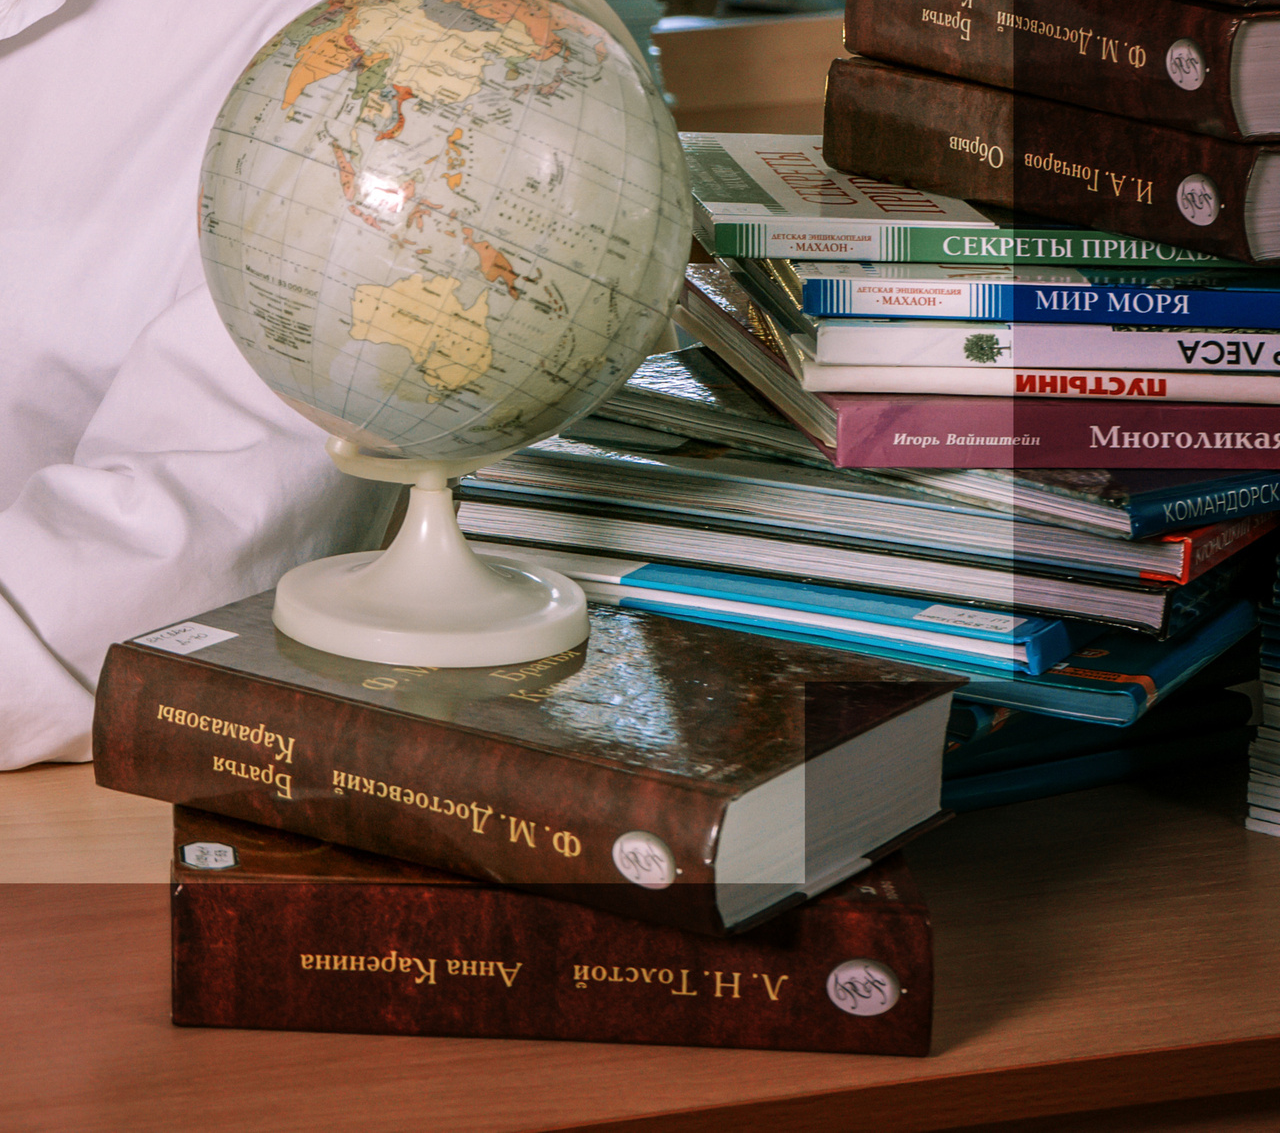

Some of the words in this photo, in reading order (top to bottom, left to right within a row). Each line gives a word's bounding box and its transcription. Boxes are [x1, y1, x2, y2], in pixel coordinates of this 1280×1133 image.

[922, 8, 972, 42] Братья
[996, 10, 1094, 56] Достоевский
[949, 135, 1005, 169] Обрыв
[755, 150, 859, 207] СЕКРЕТЫ
[1023, 152, 1101, 193] Гончаров
[771, 233, 807, 243] ДЕТСКАЯ
[808, 233, 873, 243] ЭНЦИКЛОПЕДИЯ
[795, 242, 849, 254] МАХАОН
[942, 235, 1074, 259] СЕКРЕТЫ
[857, 286, 893, 297] ДЕТСКАЯ
[894, 287, 963, 297] ЭНЦИКЛОПЕДИЯ
[881, 295, 939, 308] МАХАОН
[1035, 289, 1100, 313] МИР
[1107, 291, 1191, 316] МОРЯ
[1178, 339, 1266, 365] ЛЕСА
[1015, 374, 1168, 398] ПУСТЫНИ
[893, 433, 941, 449] Игорь
[946, 431, 1042, 448] Вайнштейн
[157, 704, 296, 764] Карамазовы
[213, 755, 294, 800] Братья
[332, 770, 493, 835] Достоевский
[300, 950, 438, 986] Каренина
[447, 958, 523, 988] Анна
[573, 964, 698, 997] Толстой
